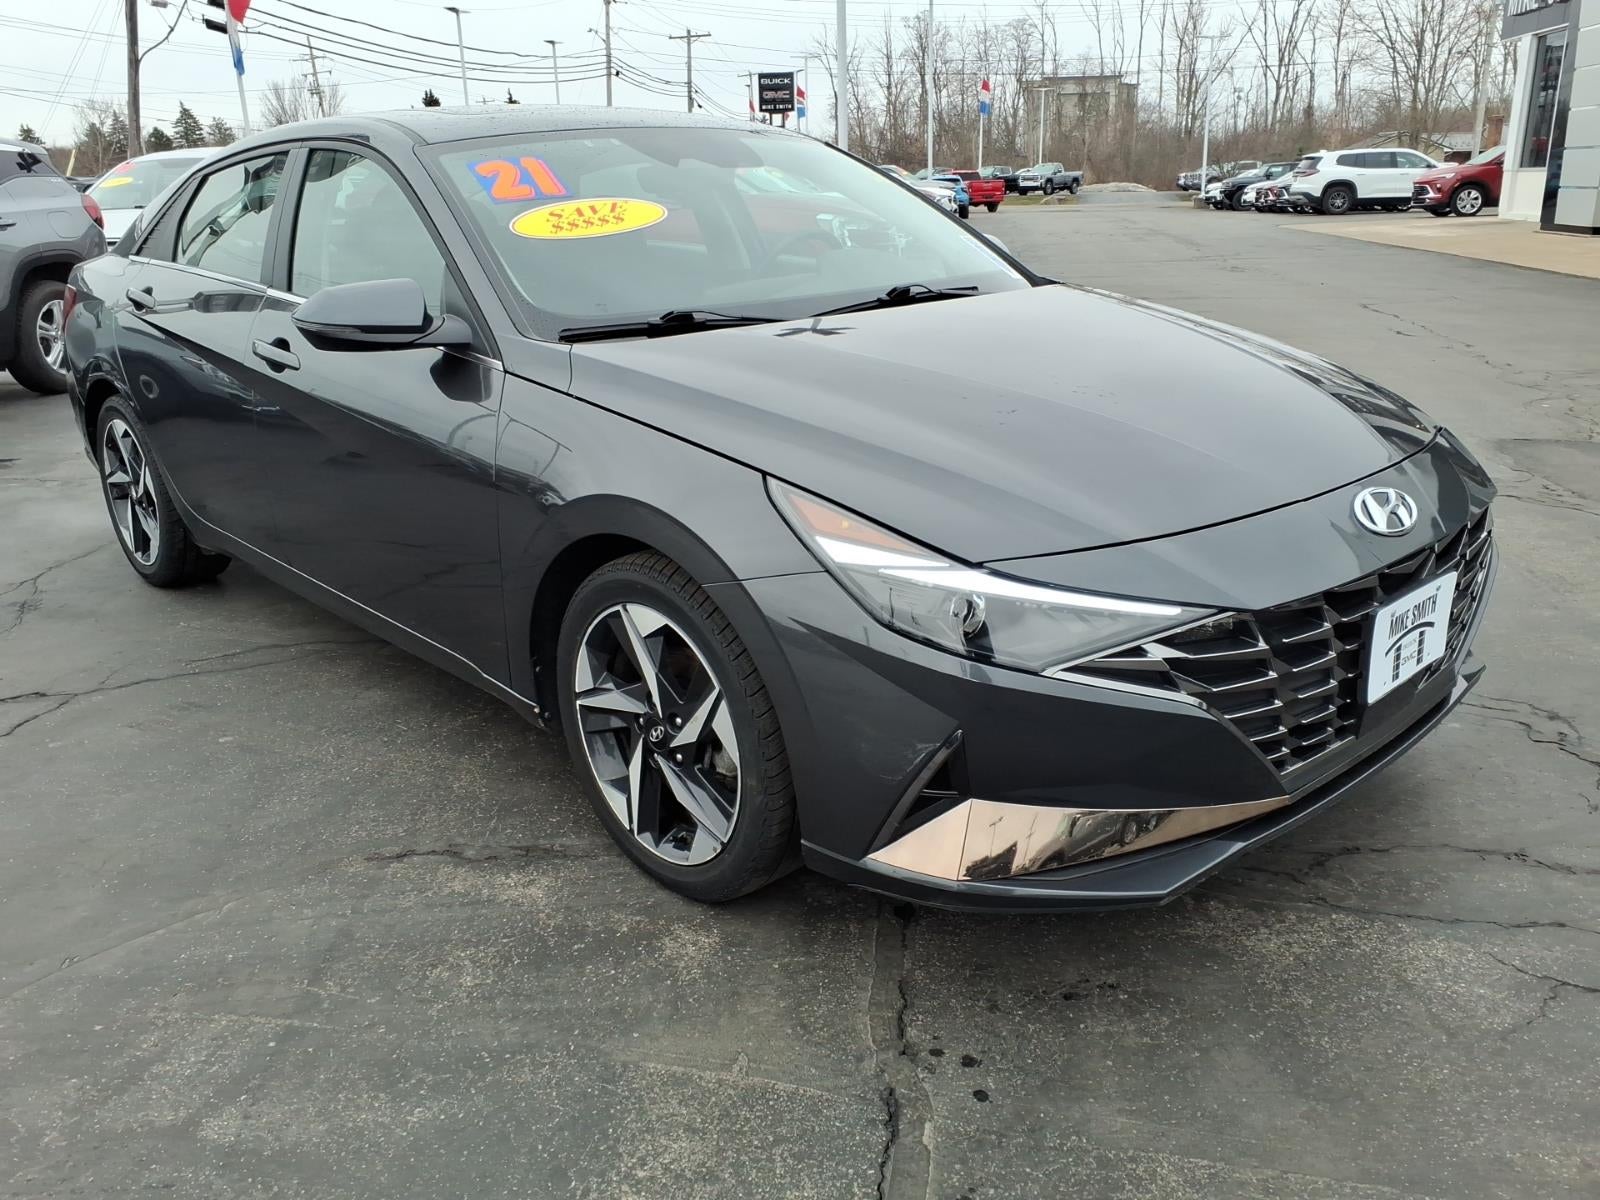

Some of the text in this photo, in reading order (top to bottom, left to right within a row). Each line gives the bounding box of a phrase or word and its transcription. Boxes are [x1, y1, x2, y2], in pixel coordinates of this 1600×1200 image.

[475, 156, 568, 200] 21
[546, 201, 628, 222] SAVE
[1388, 593, 1438, 640] MIKE SMITH
